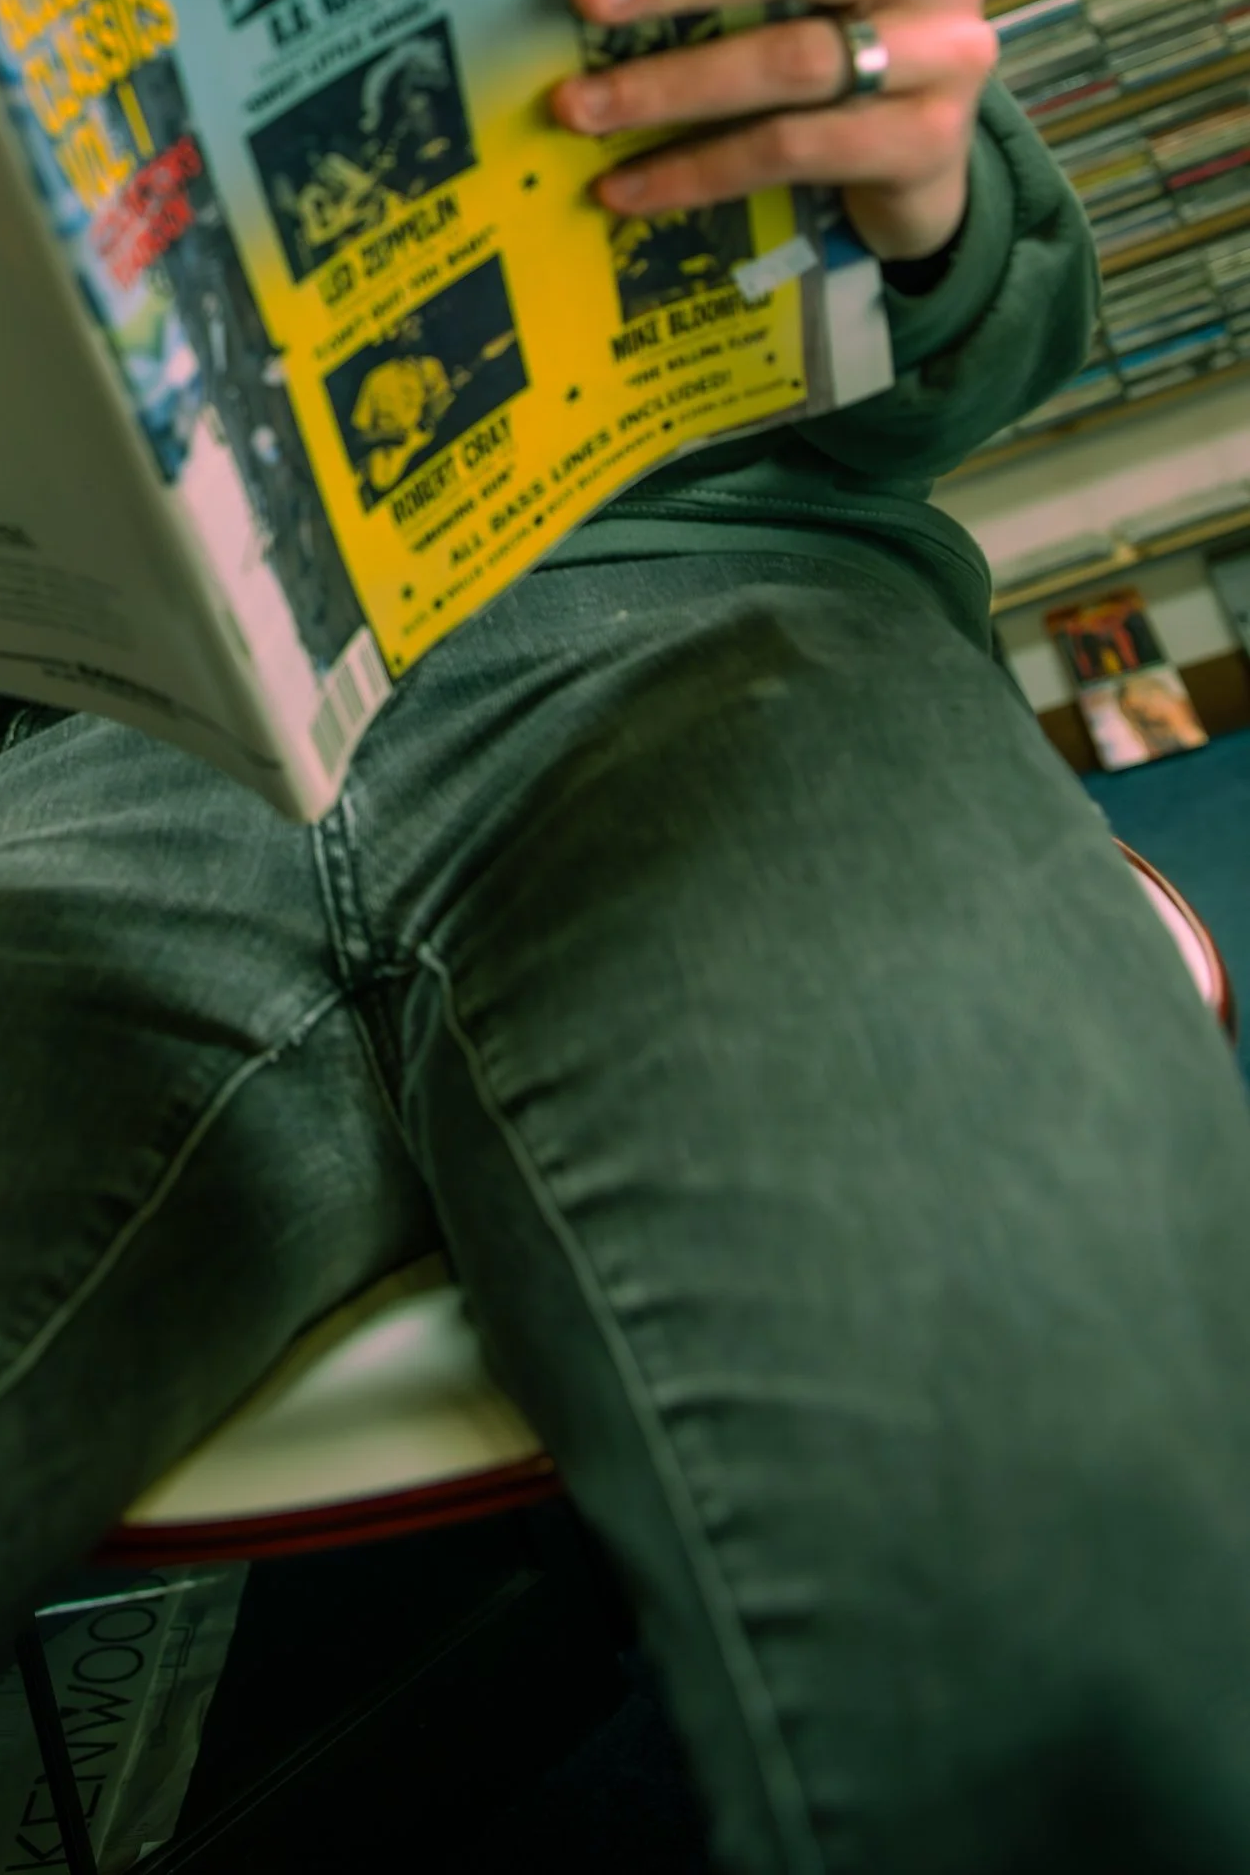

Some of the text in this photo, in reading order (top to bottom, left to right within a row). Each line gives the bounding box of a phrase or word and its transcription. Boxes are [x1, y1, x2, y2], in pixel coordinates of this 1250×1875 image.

[361, 194, 461, 277] ZEPPELIN
[451, 531, 485, 569] ALL
[488, 479, 546, 535] BASS
[551, 428, 612, 485] LINES
